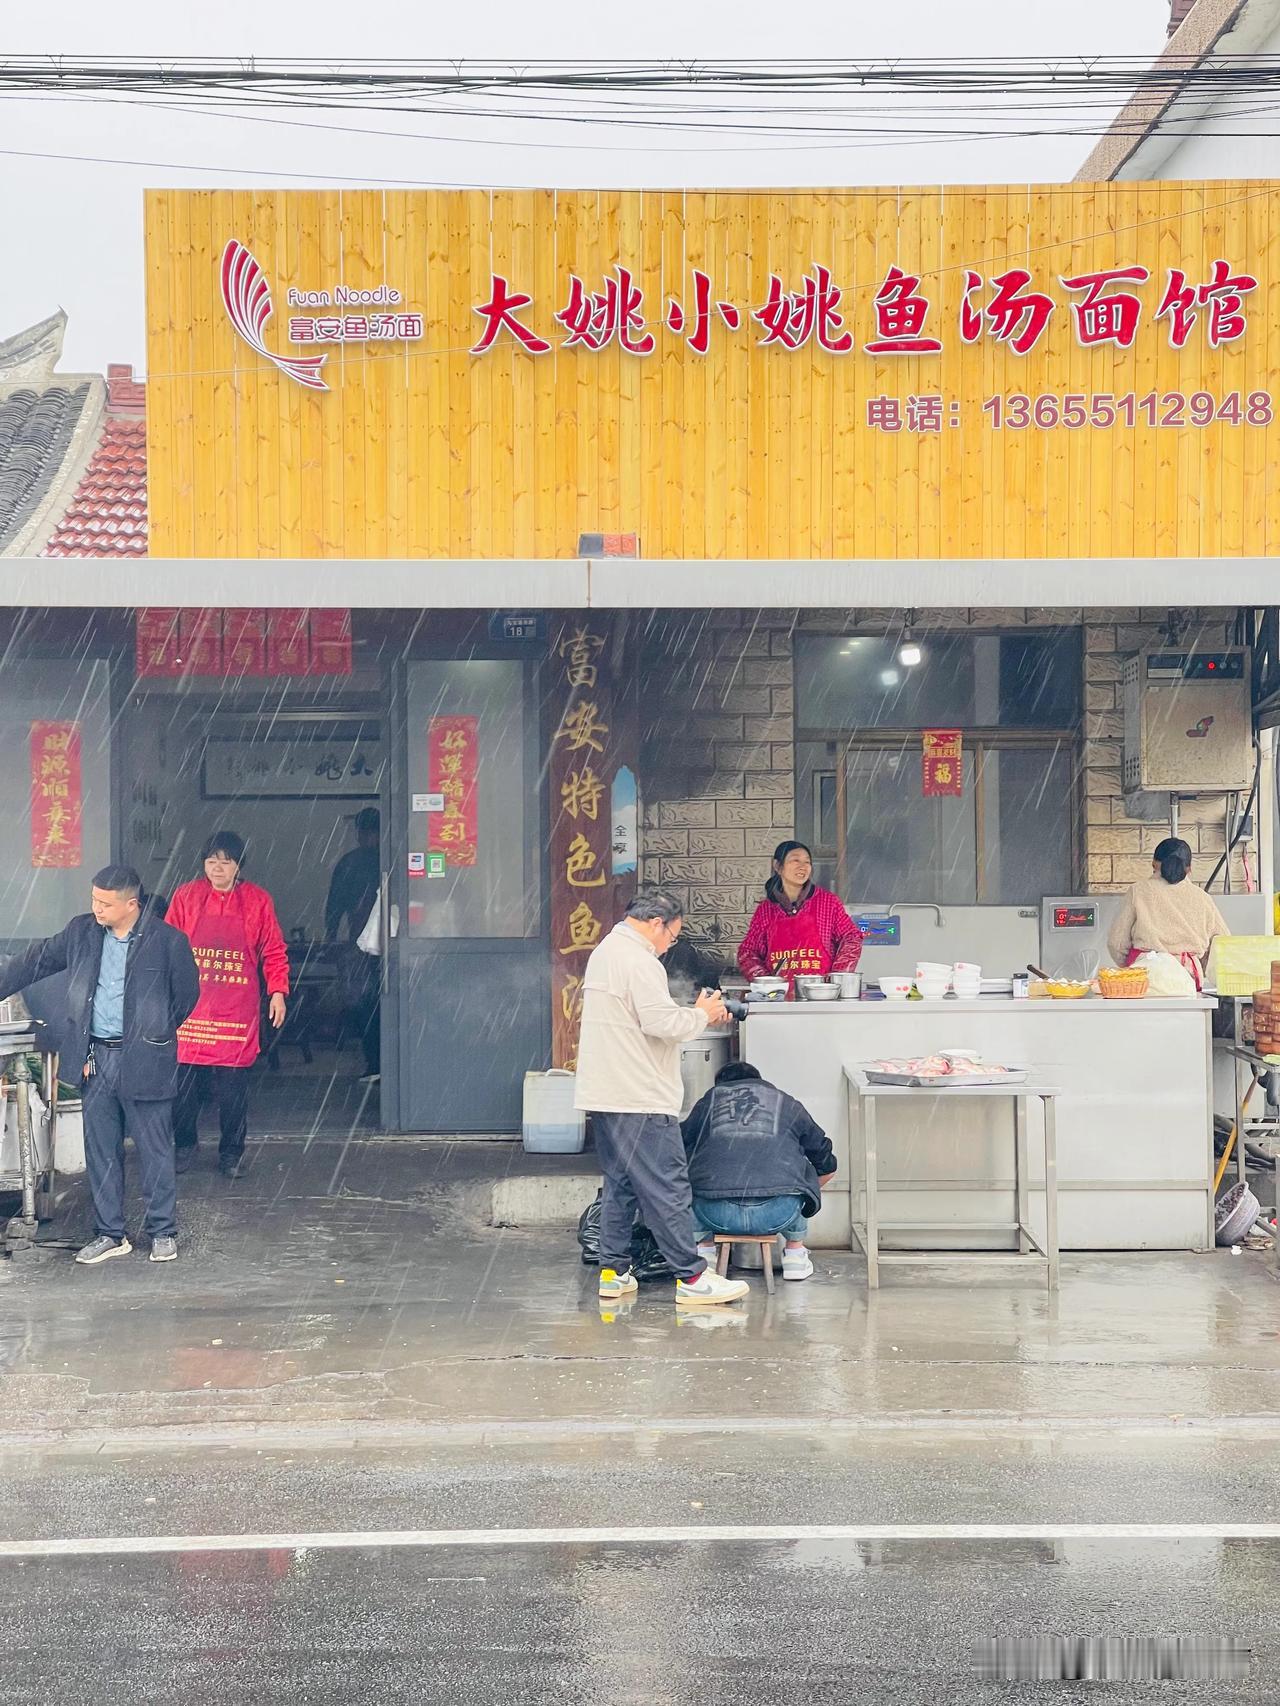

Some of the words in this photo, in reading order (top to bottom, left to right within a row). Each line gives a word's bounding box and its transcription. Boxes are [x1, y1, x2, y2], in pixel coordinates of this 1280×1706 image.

[287, 287, 331, 307] Fuan
[335, 285, 402, 305] Noodle
[470, 260, 1258, 356] 大姚小姚鱼汤面馆
[288, 314, 424, 342] 富安鱼汤面
[982, 390, 1274, 429] 13655112948
[935, 763, 952, 784] 福
[553, 626, 609, 1072] 富安特色鱼
[191, 947, 246, 962] SUNFEEL
[770, 948, 823, 962] SUNFEEL
